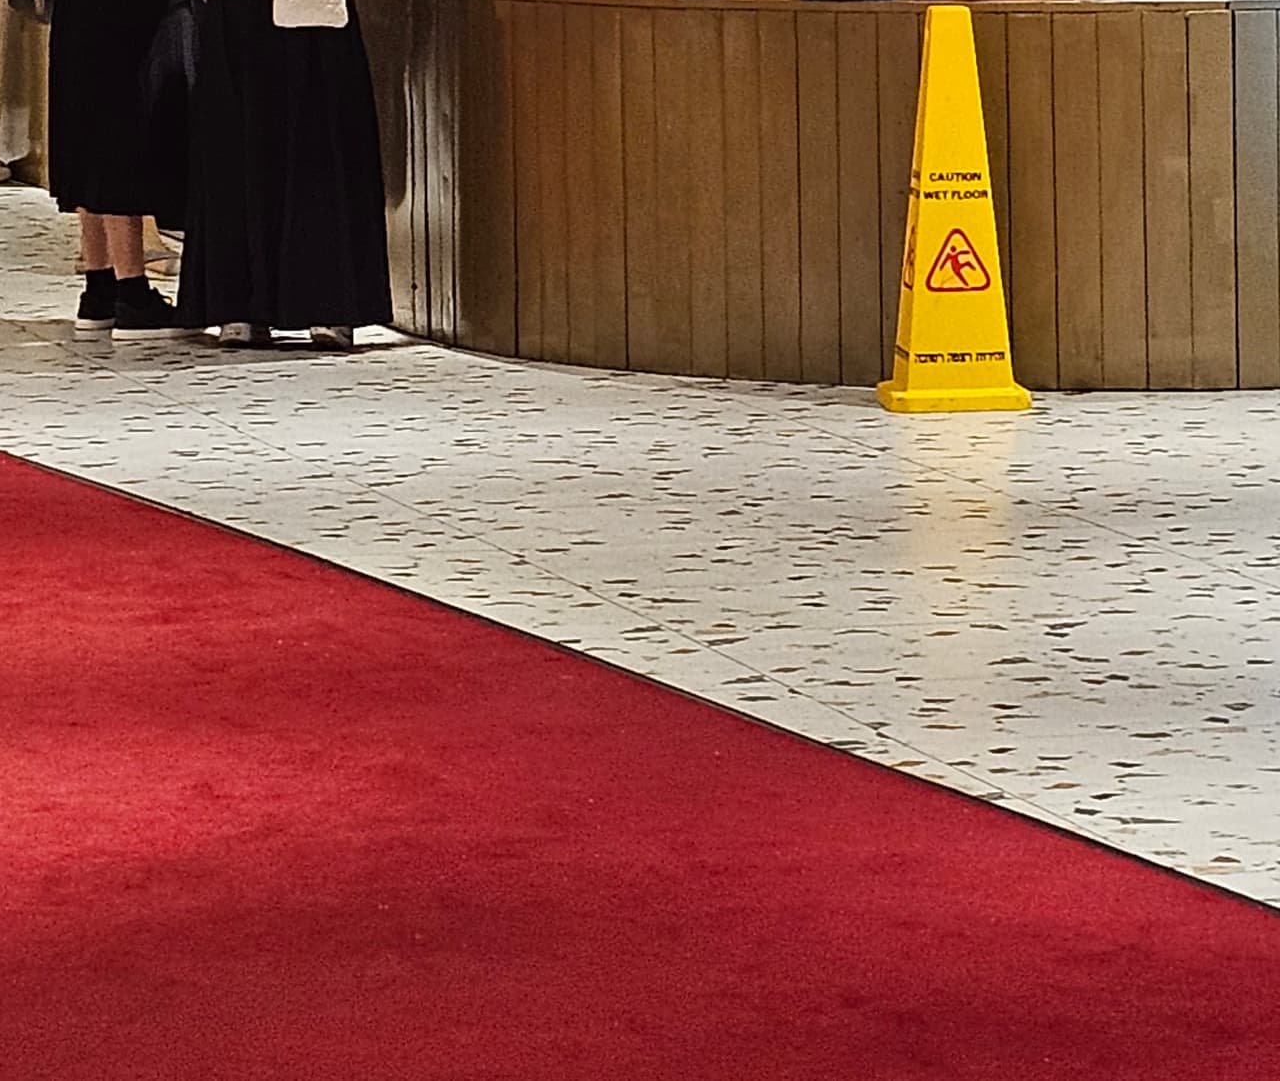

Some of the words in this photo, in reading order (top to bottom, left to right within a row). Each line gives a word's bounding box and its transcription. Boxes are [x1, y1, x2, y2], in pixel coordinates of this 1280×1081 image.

[929, 172, 982, 182] CAUTION
[923, 190, 949, 200] WET
[951, 189, 988, 200] FLOOR
